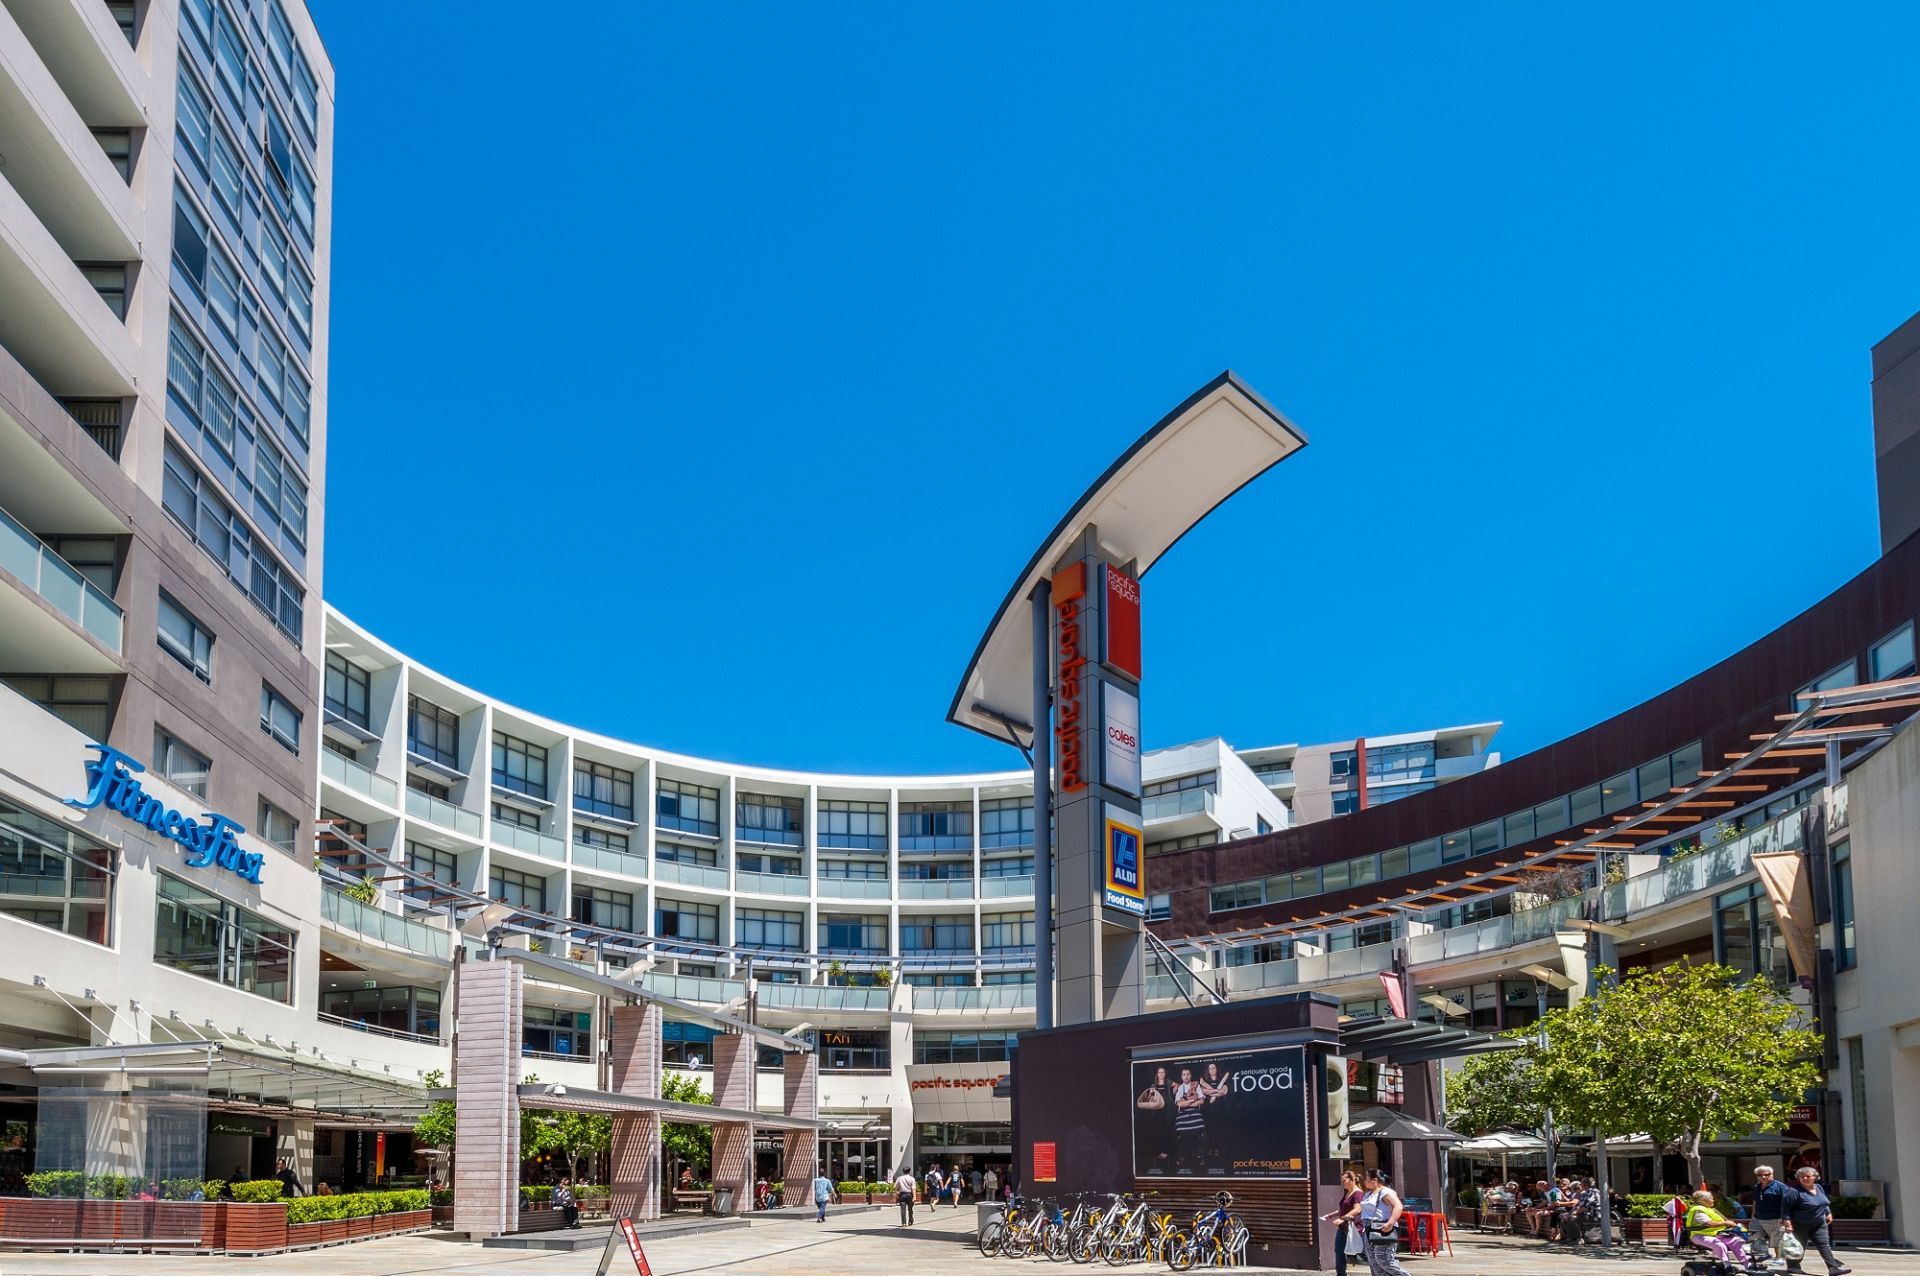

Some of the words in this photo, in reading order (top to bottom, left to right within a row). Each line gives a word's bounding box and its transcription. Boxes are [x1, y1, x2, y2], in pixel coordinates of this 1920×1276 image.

[1107, 570, 1136, 595] pacific
[1110, 580, 1140, 606] square
[1060, 601, 1087, 699] square
[1054, 700, 1088, 794] pacific
[1108, 726, 1136, 748] coles
[62, 744, 206, 856] Fitness
[185, 813, 266, 885] First
[1114, 867, 1137, 885] ALDI
[1107, 891, 1125, 906] Food
[1125, 897, 1144, 912] Store
[1231, 1067, 1293, 1093] food
[1240, 1067, 1268, 1076] seriously
[1269, 1066, 1289, 1075] good
[911, 1076, 952, 1092] pacific
[953, 1078, 998, 1091] square
[1233, 1158, 1260, 1169] pacific
[1260, 1160, 1290, 1169] square
